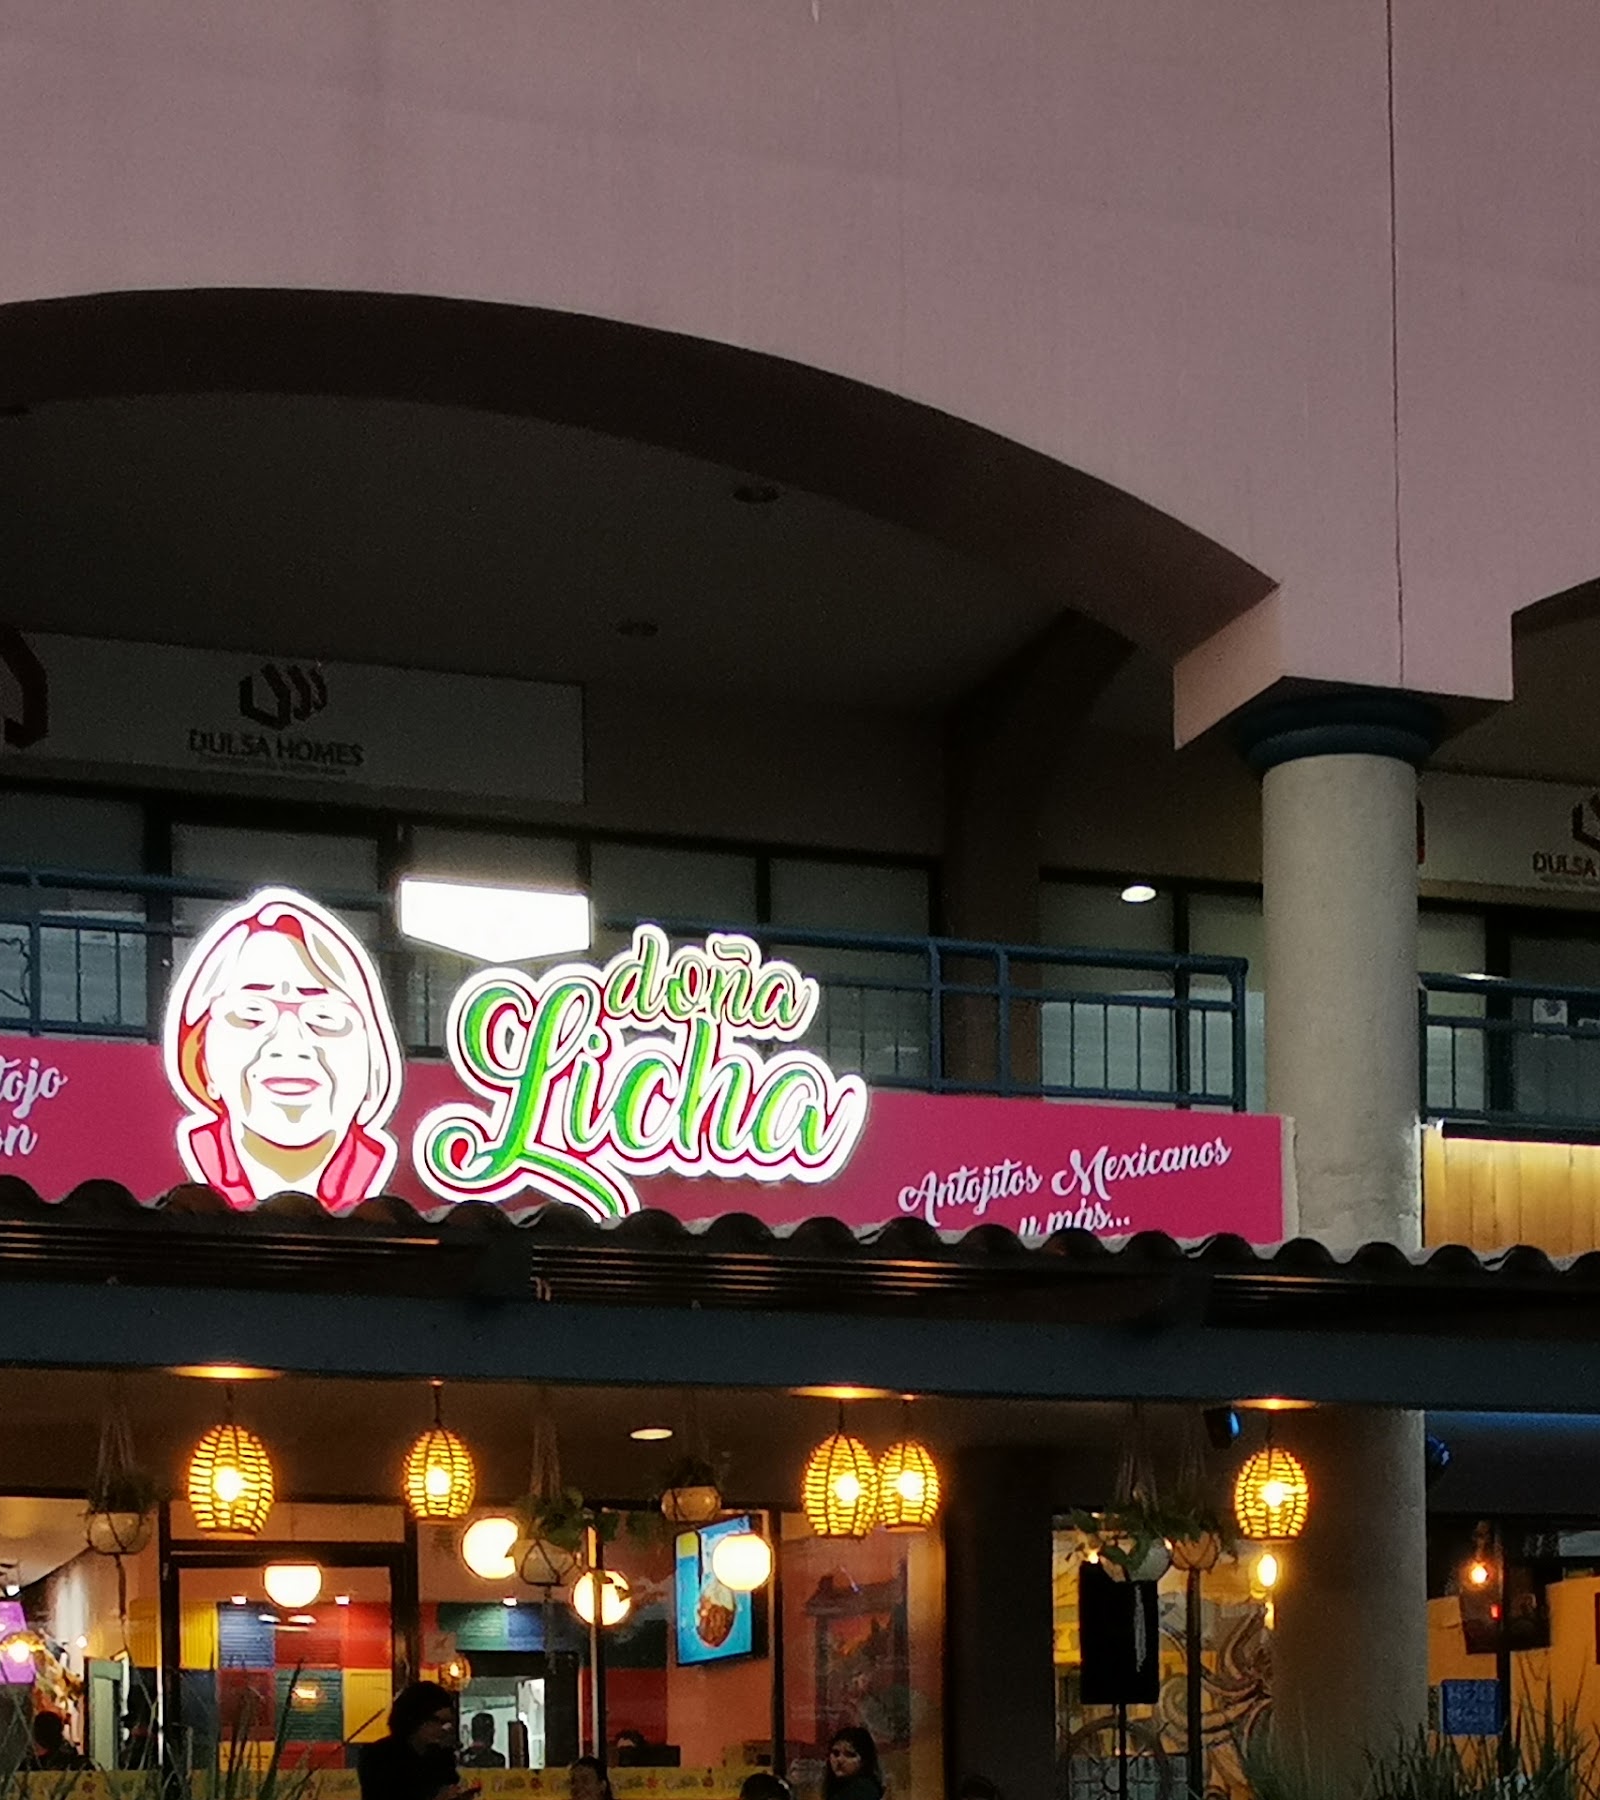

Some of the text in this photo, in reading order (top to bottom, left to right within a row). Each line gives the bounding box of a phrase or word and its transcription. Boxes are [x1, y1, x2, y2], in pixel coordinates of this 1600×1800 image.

[188, 728, 272, 758] DULSA
[276, 736, 365, 767] HOMES
[1532, 850, 1597, 877] DULSA
[605, 930, 812, 1033] doña
[422, 974, 858, 1218] Licha
[897, 1135, 1233, 1228] Antojitos Mexicanos
